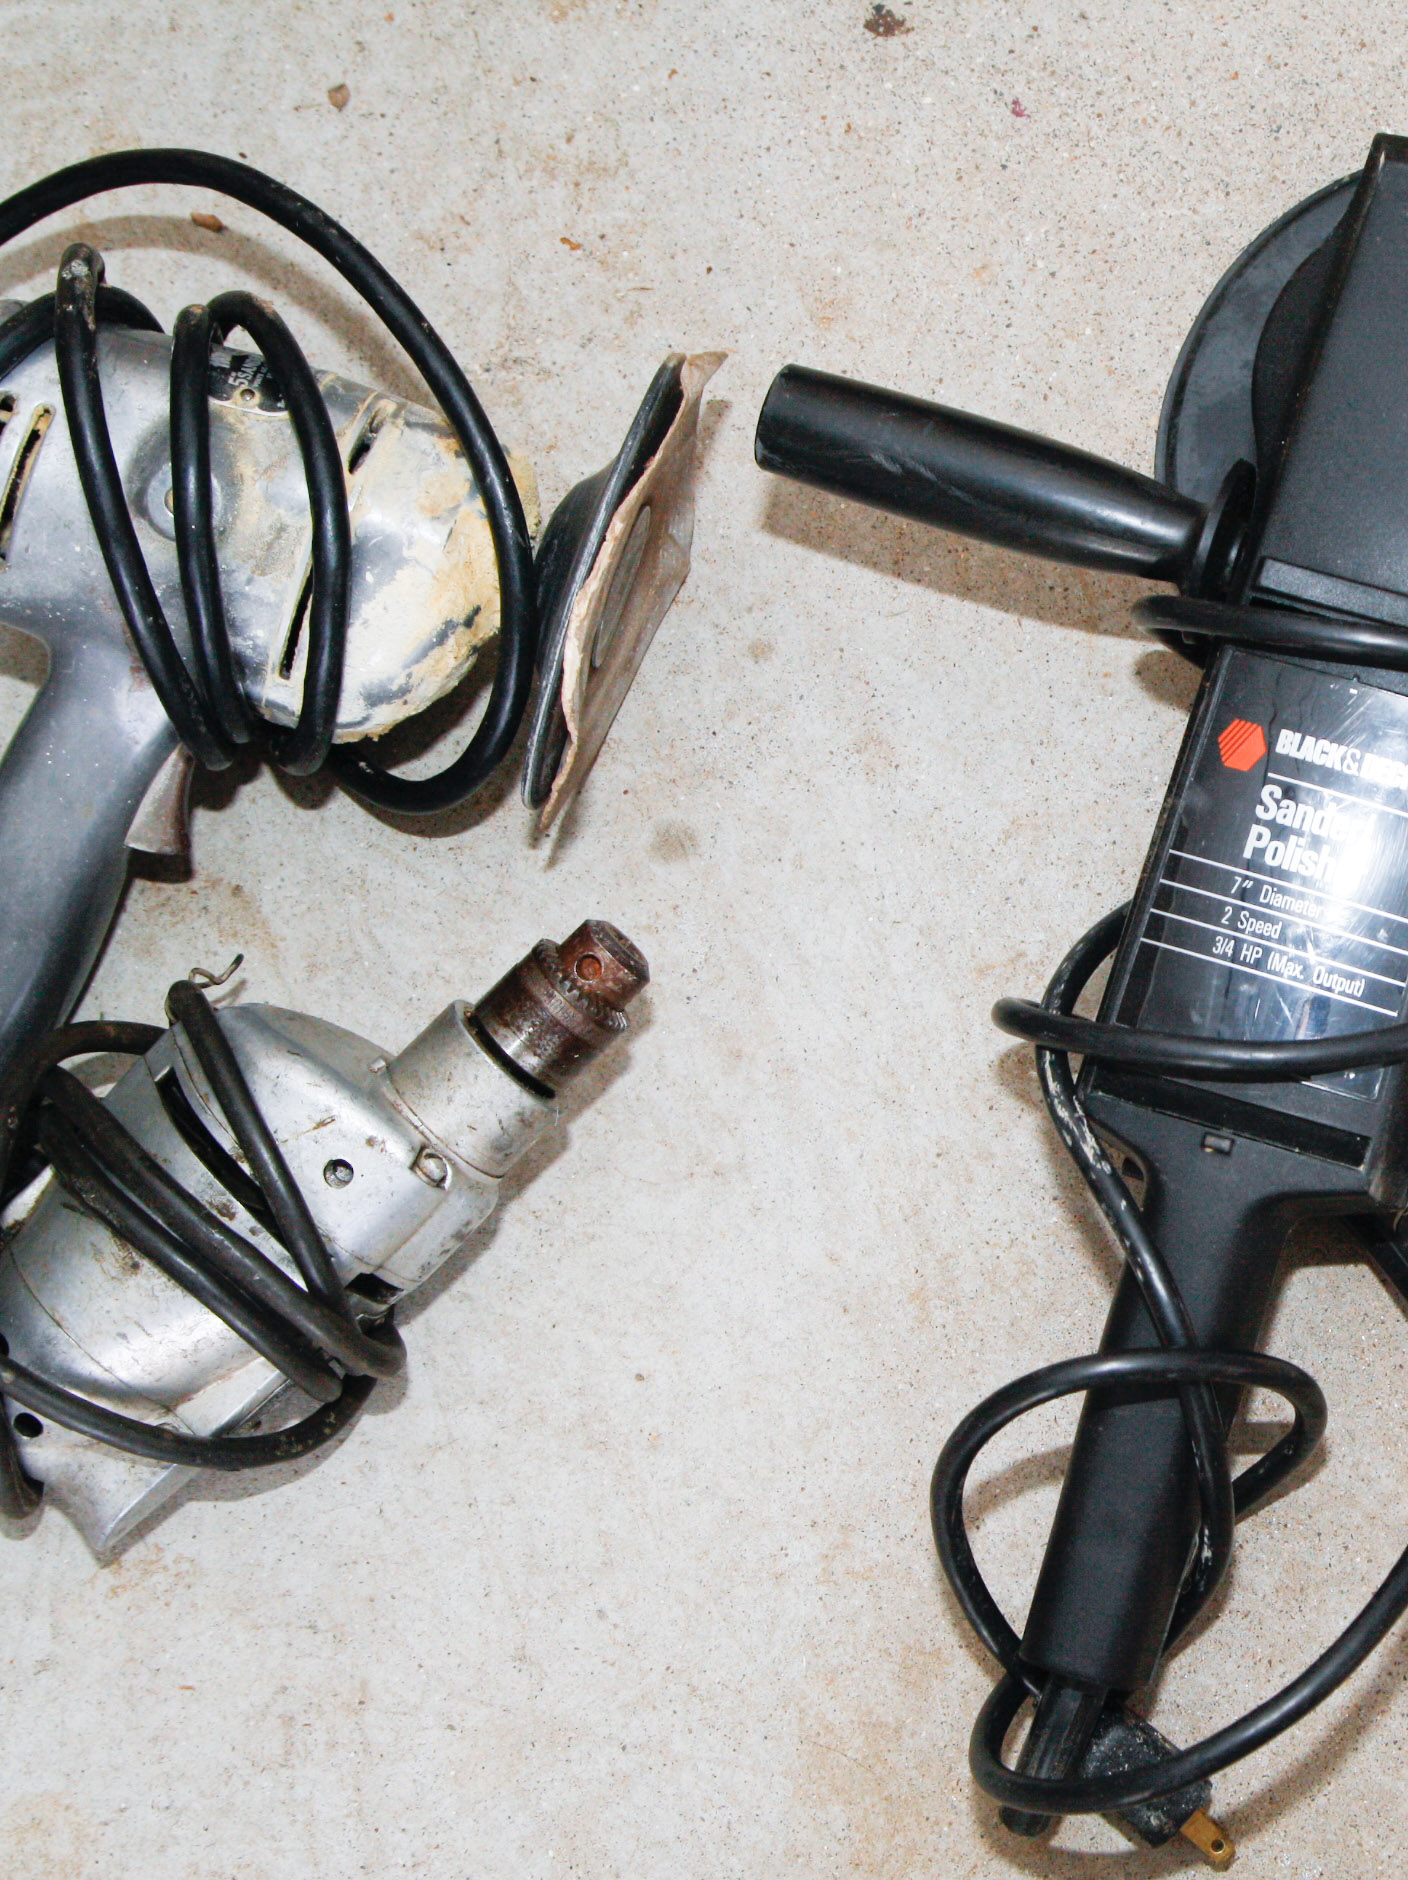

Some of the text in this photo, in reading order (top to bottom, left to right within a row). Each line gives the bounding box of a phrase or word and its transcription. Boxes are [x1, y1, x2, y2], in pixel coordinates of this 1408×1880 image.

[1260, 884, 1323, 919] Diameter
[1221, 905, 1283, 942] 2 Speed
[1212, 935, 1365, 998] 3/4 HP (Max. Output)
